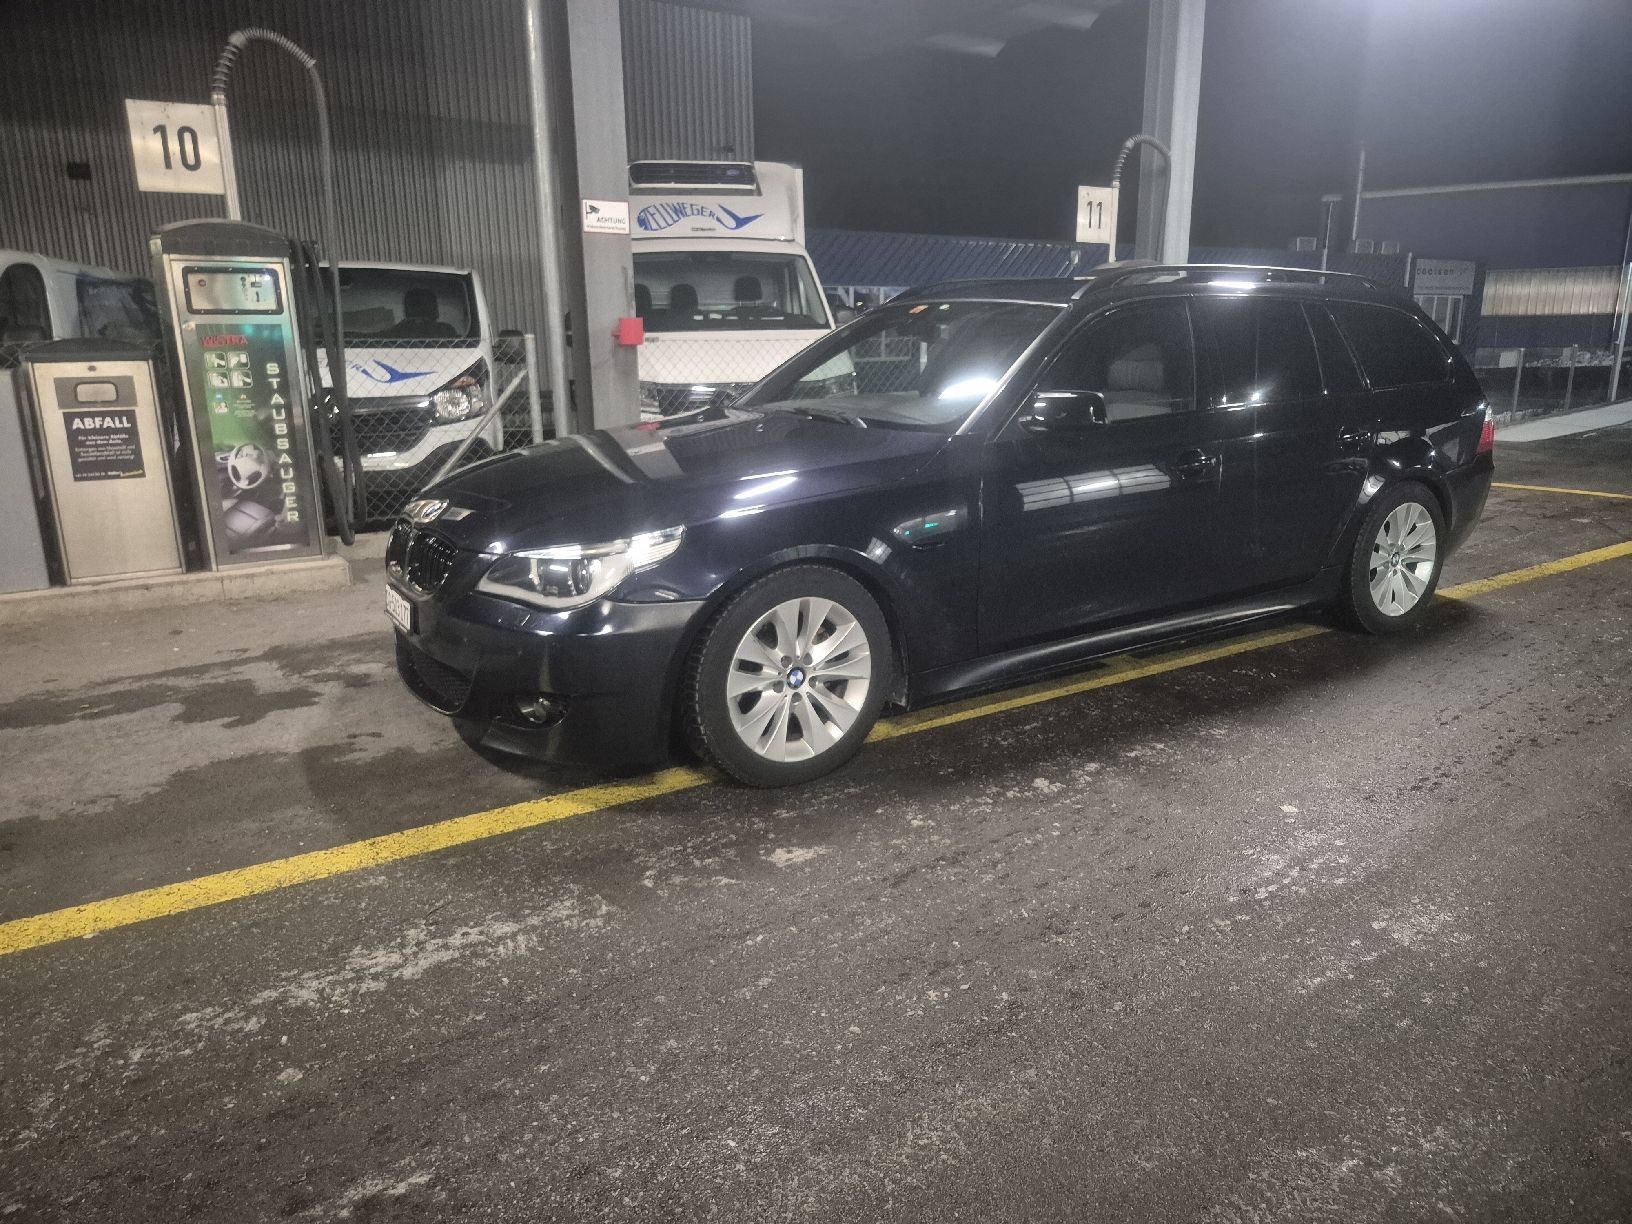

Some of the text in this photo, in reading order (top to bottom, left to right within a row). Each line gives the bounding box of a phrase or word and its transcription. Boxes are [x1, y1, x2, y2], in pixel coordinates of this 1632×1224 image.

[153, 124, 201, 171] 10
[597, 217, 626, 225] ACHTUNG
[638, 202, 716, 231] ZELLWEGER
[1087, 201, 1102, 229] 11
[72, 416, 132, 429] ABFALL
[266, 362, 299, 522] STAUBSAUGER
